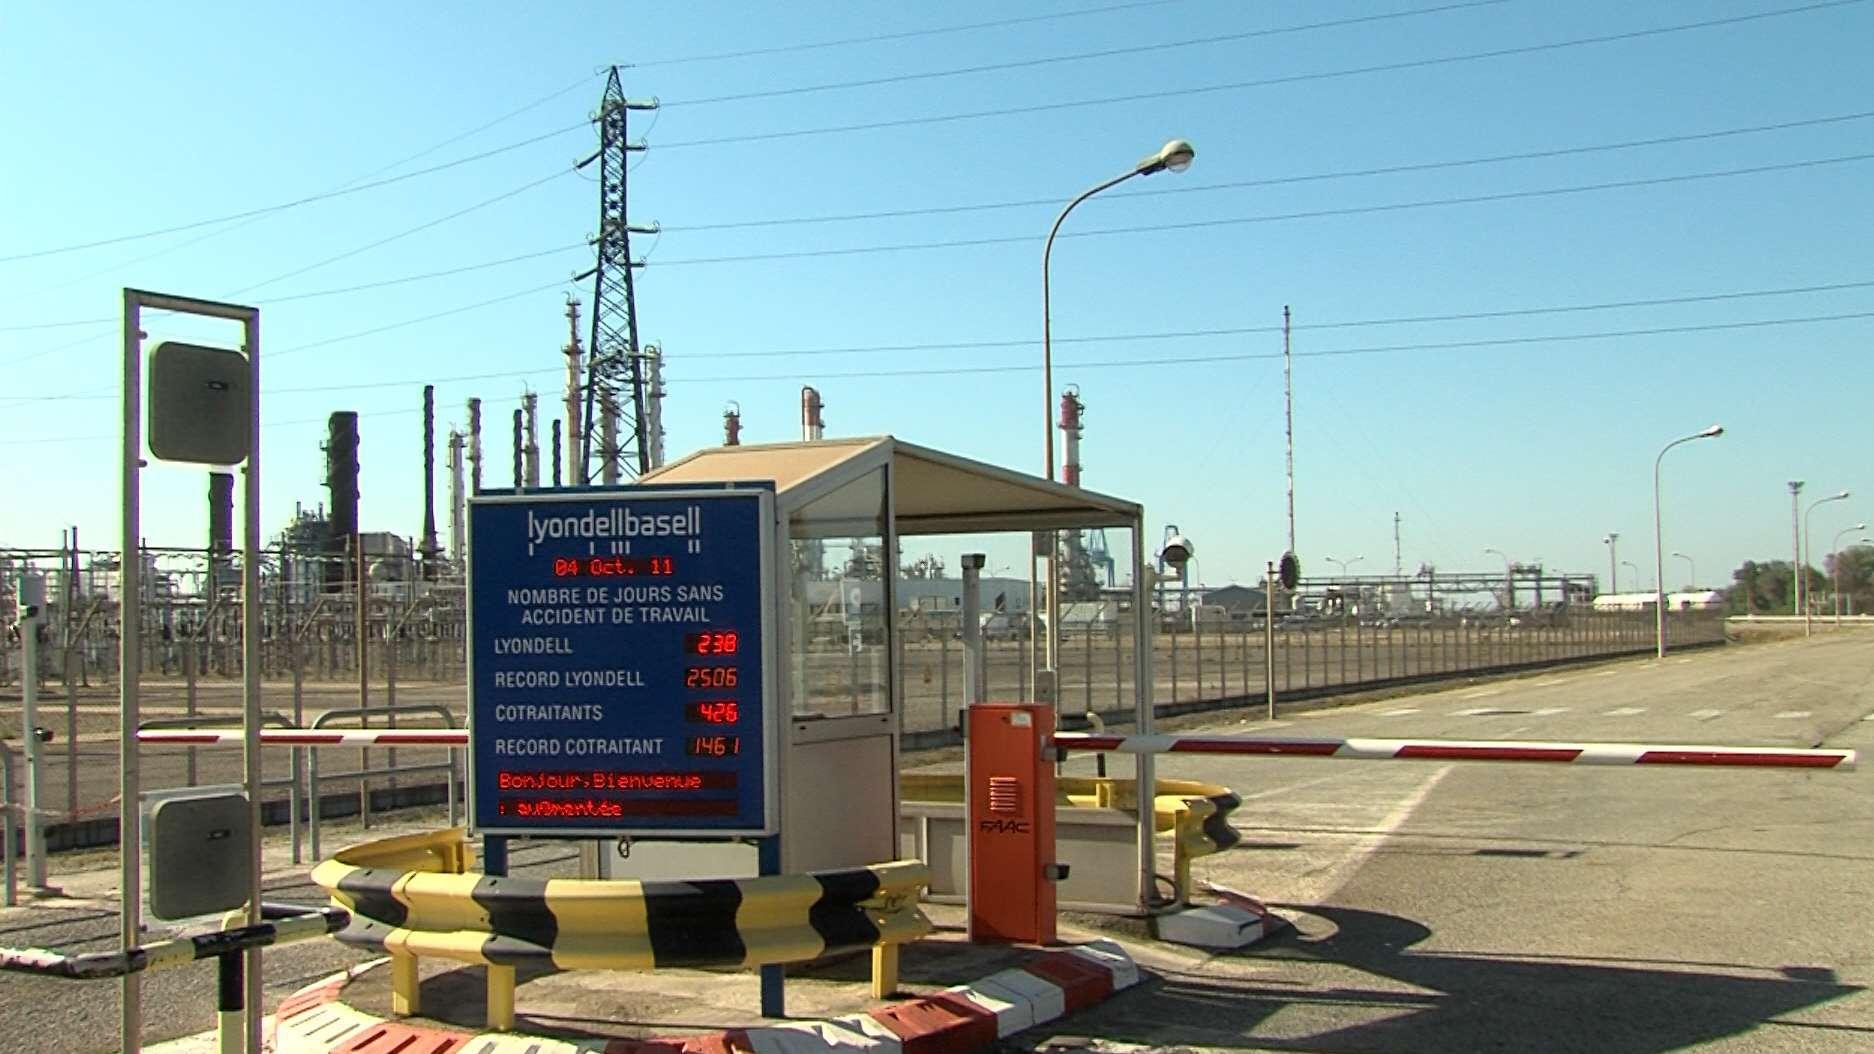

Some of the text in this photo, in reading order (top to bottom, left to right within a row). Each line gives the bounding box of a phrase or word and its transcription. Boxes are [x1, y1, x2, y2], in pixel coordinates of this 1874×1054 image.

[528, 506, 700, 544] lyondellbasell
[555, 558, 673, 576] 04 Oct. 11
[508, 585, 723, 604] NOMBRE DE JOURS SANS
[521, 606, 710, 624] ACCIDENT DE TRAVAIL
[495, 638, 573, 654] LYONDELL
[698, 634, 737, 653] 238
[495, 671, 645, 688] RECORD LYONDELL
[687, 668, 737, 687] 2506
[495, 705, 602, 721] COTRAITANTS
[701, 703, 737, 722] 426
[495, 739, 664, 755] RECORD COTRAITANT
[696, 737, 740, 755] 1461
[980, 819, 1030, 833] FAAC
